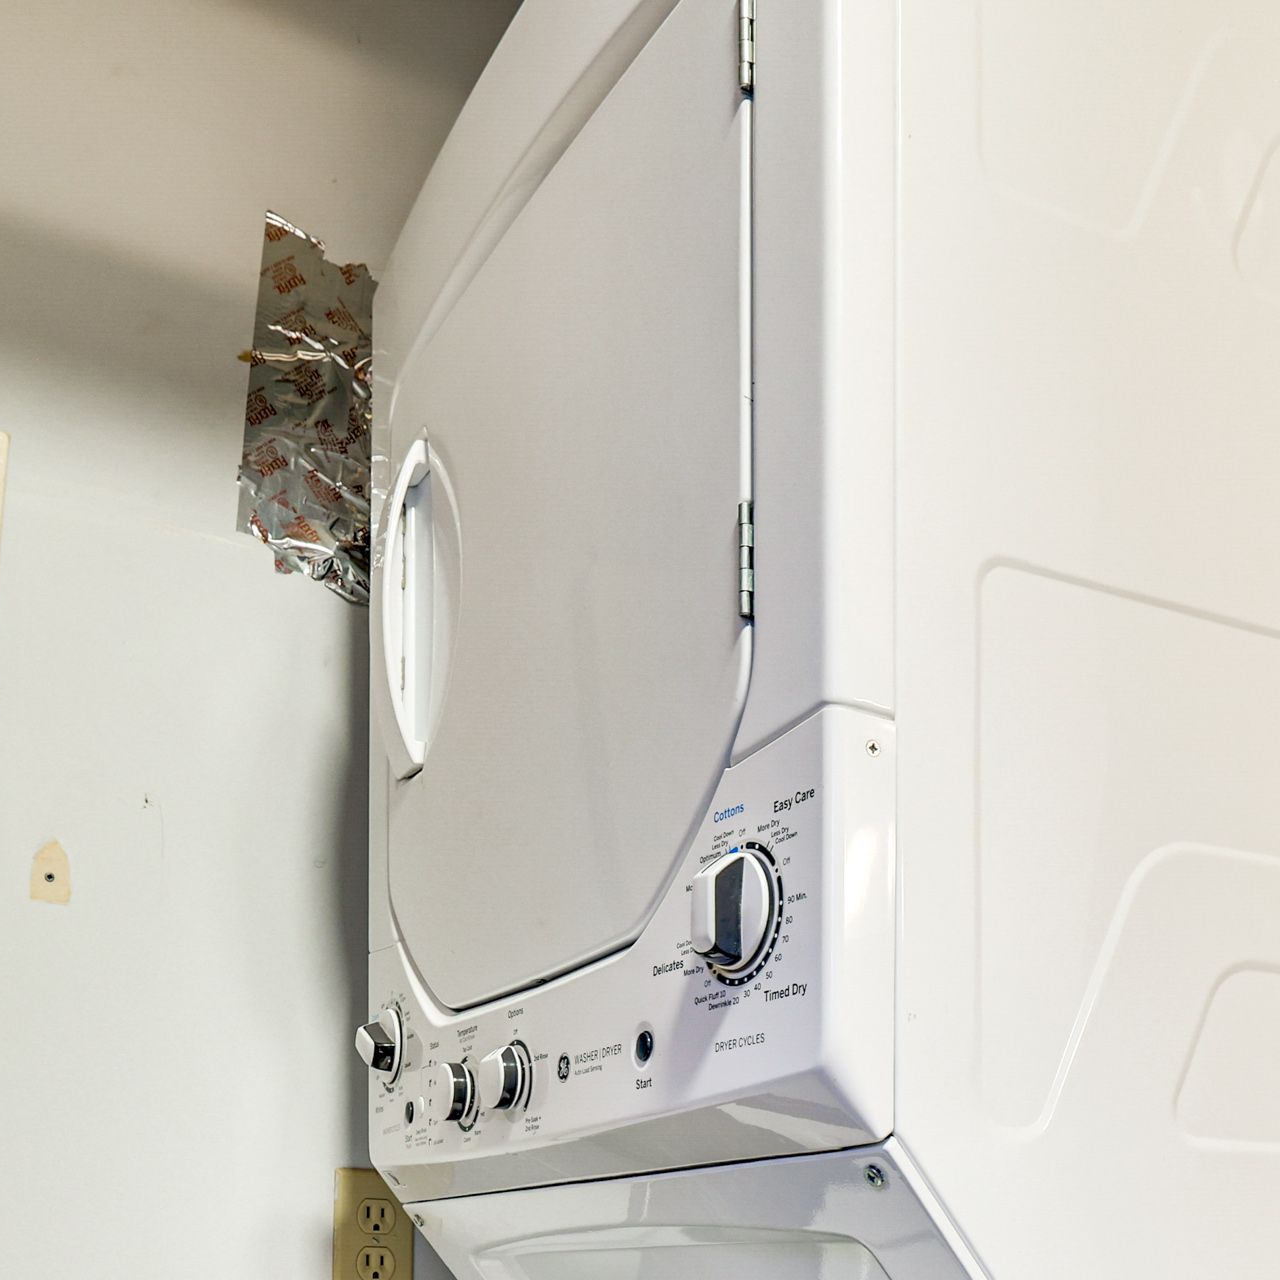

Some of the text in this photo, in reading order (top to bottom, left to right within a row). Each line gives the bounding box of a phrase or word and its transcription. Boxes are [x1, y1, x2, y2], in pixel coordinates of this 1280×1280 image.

[773, 788, 815, 813] Easy Care
[713, 803, 745, 823] Cottons
[771, 819, 780, 830] Dry
[785, 916, 793, 925] 80
[782, 935, 789, 944] 70
[775, 953, 782, 962] 60
[653, 960, 684, 976] Delicates
[766, 971, 773, 979] 50
[764, 983, 808, 1002] Timed Dry
[715, 1032, 765, 1052] DRYER CYCLES
[574, 1044, 622, 1065] WASHER DRYER
[636, 1077, 653, 1090] Start
